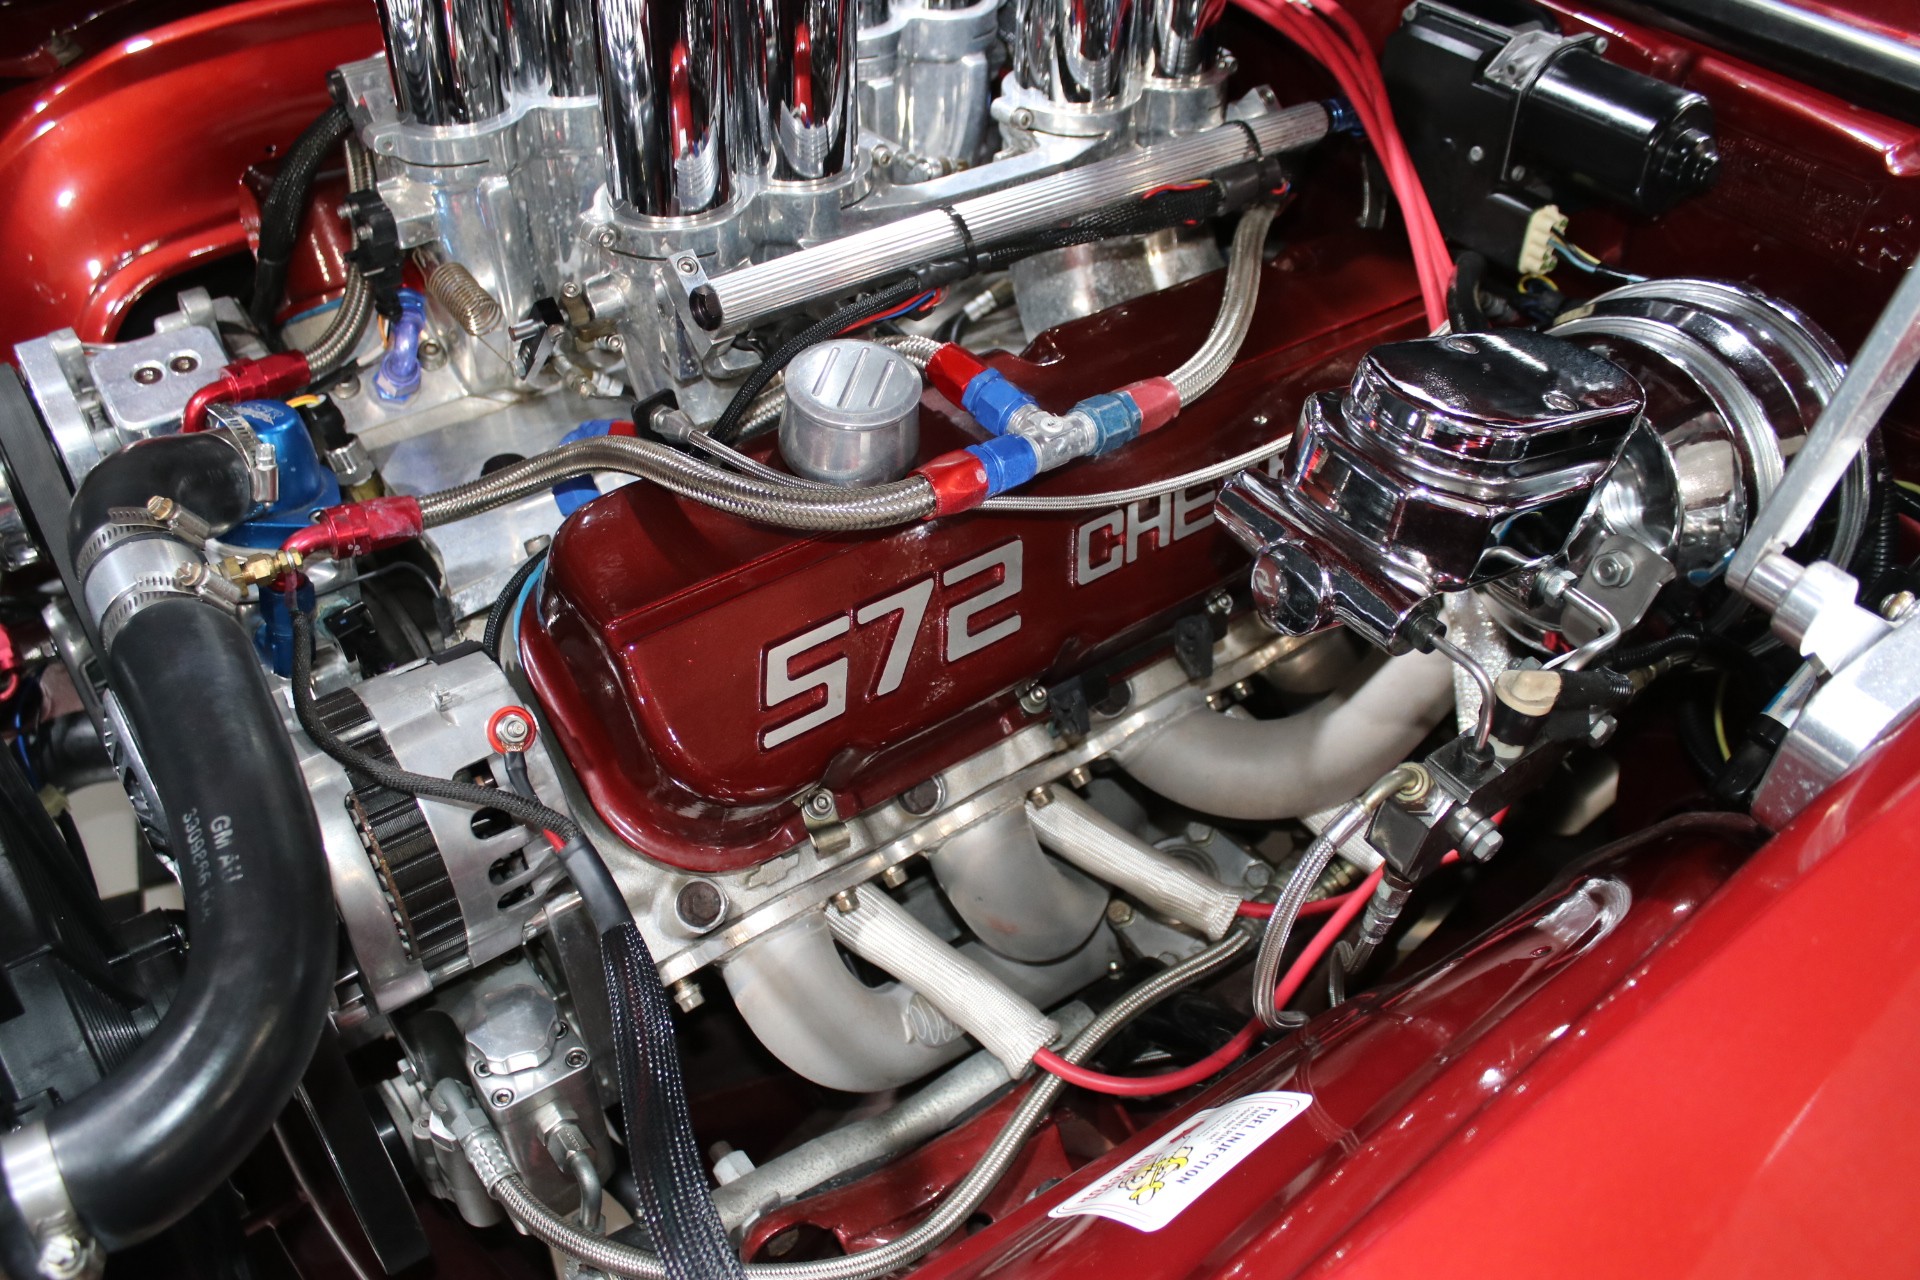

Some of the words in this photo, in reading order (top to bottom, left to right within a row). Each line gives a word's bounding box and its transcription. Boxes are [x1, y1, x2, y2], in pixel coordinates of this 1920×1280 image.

[763, 540, 1024, 749] 572
[1078, 478, 1230, 586] CHE
[210, 815, 234, 850] GM
[1241, 1108, 1278, 1130] FUEL
[1176, 1132, 1246, 1184] INJECTION
